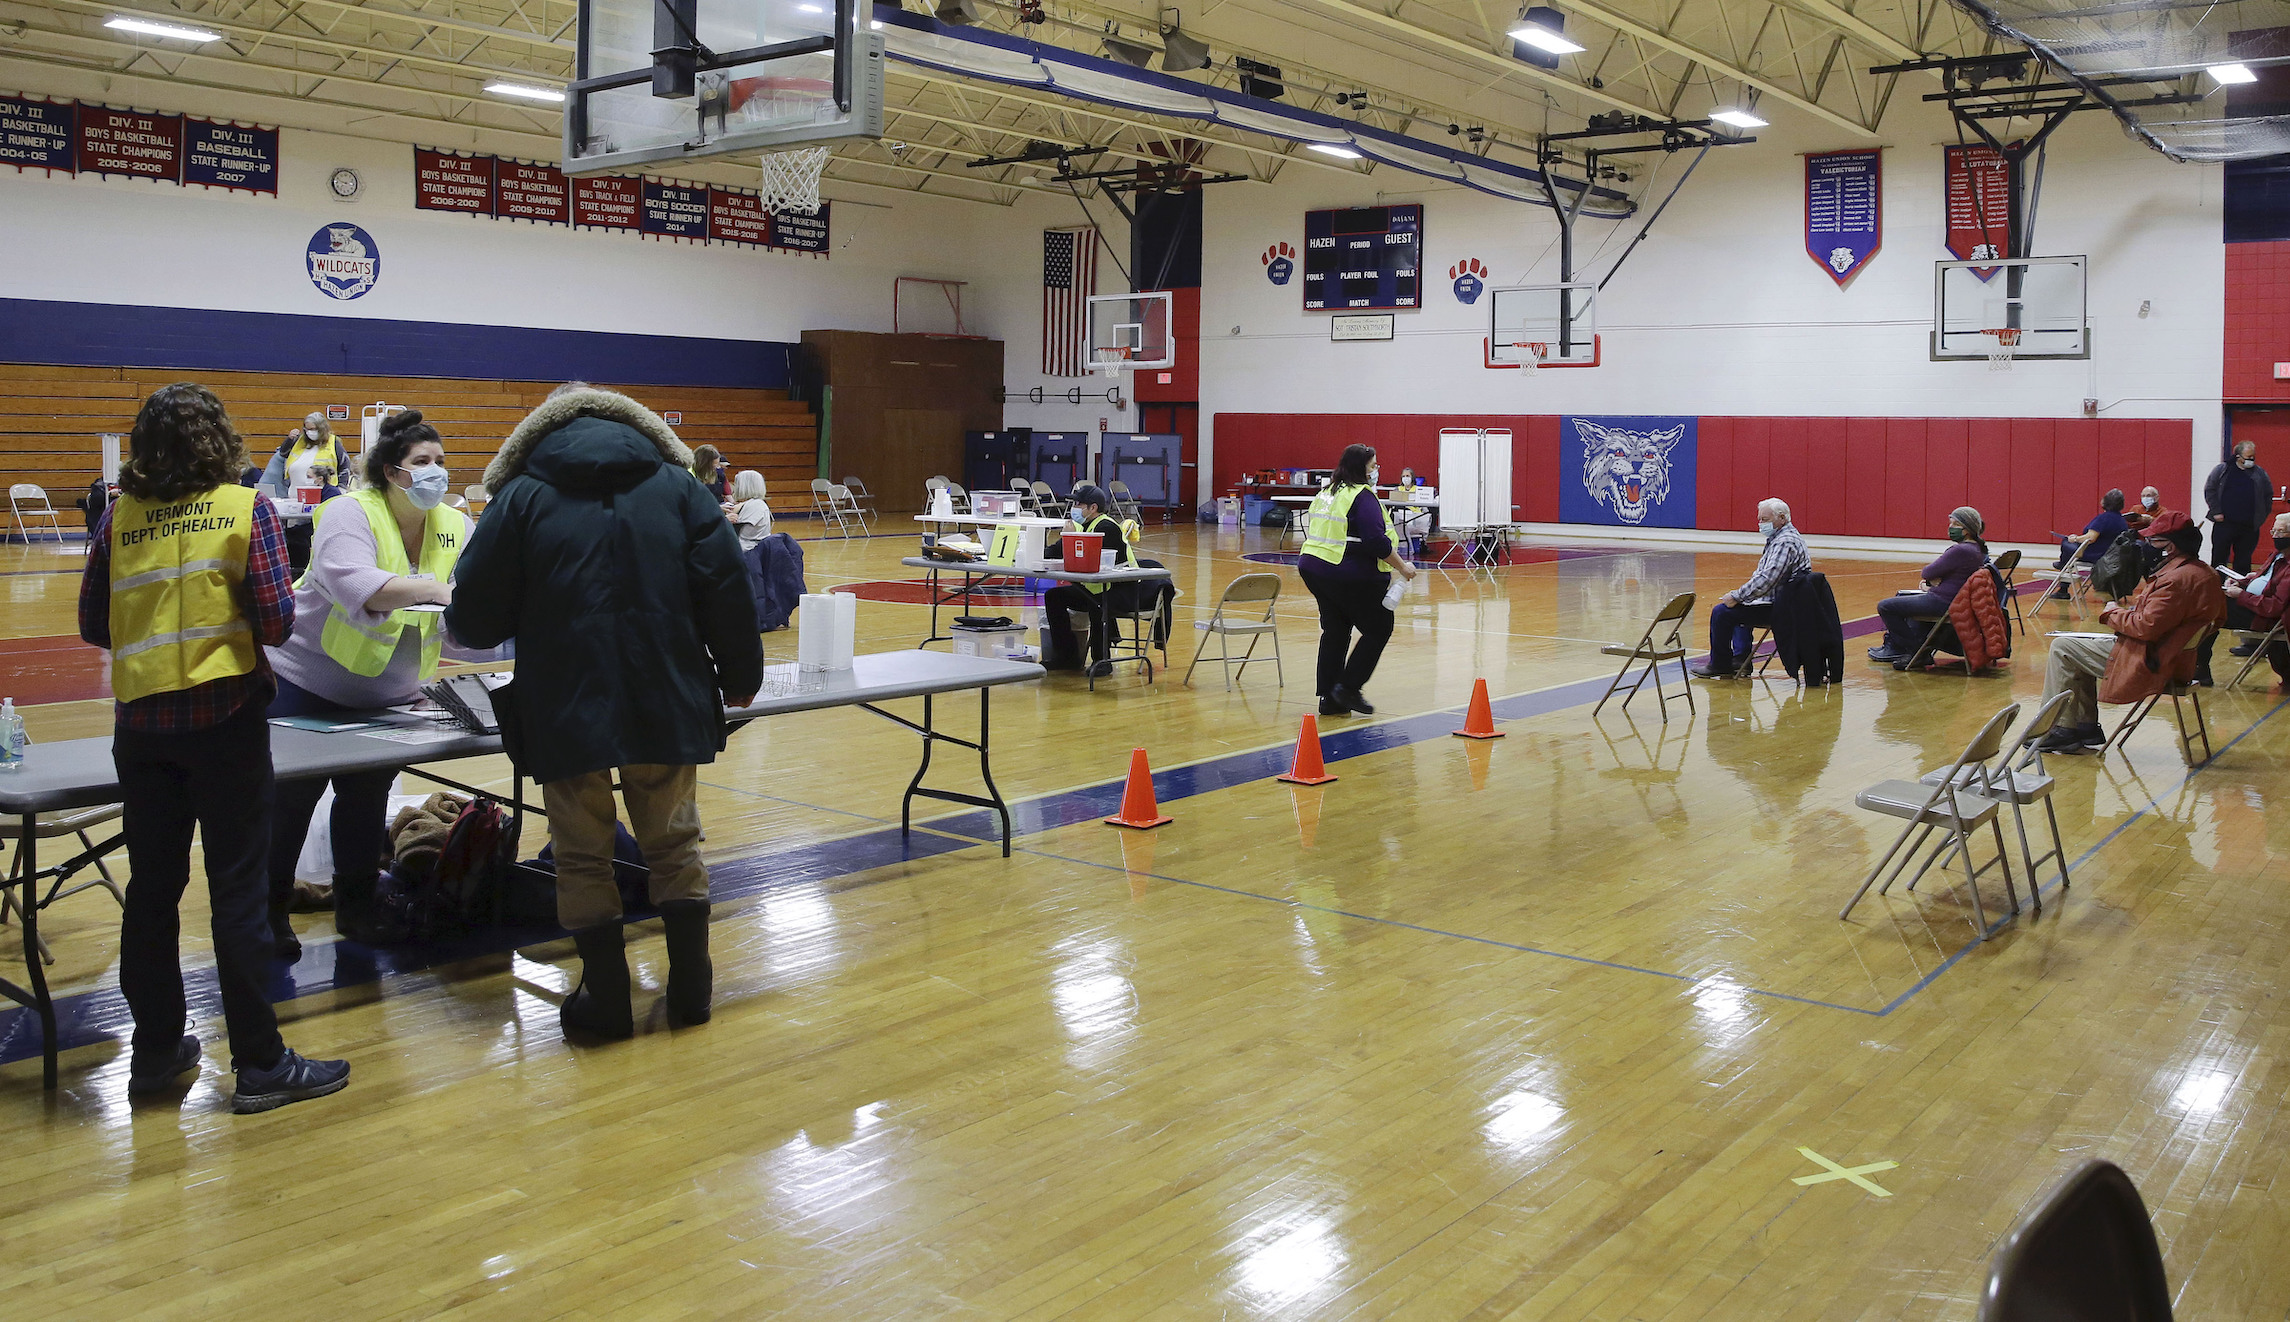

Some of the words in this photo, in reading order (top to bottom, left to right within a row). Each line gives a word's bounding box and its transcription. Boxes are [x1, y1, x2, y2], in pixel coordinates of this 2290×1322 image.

[0, 103, 23, 116] DIV.
[27, 107, 43, 119] III
[2, 118, 67, 137] BASKETBALL
[108, 116, 134, 129] DIV.
[138, 120, 153, 131] III
[8, 134, 66, 150] RUNNER-UP
[85, 126, 110, 139] BOYS
[114, 130, 175, 147] BASKETBALL
[211, 129, 235, 142] DIV.
[238, 133, 254, 144] III
[0, 147, 48, 161] 004-05
[87, 141, 118, 154] STATE
[122, 145, 173, 161] CHAMPIONS
[196, 141, 267, 160] BASEBALL
[97, 158, 163, 173] 2005-2006
[191, 154, 218, 167] STATE
[221, 158, 271, 173] RUNNER-UP
[439, 159, 458, 170] DIV.
[460, 162, 471, 171] III
[216, 171, 246, 182] 2007
[421, 169, 440, 180] BOYS
[442, 172, 487, 185] BASKETBALL
[517, 168, 536, 179] DIV.
[537, 171, 548, 181] III
[423, 182, 446, 194] STATE
[448, 185, 486, 197] CHAMPIONS
[501, 178, 519, 190] BOYS
[521, 181, 564, 194] BASKETBALL
[592, 180, 610, 190] DIV.
[611, 181, 622, 190] IV
[503, 191, 524, 202] STATE
[526, 193, 562, 206] CHAMPIONS
[579, 189, 594, 199] BOYS
[595, 191, 613, 201] TRACK
[620, 193, 636, 203] FIELD
[662, 189, 678, 199] DIV.
[680, 192, 691, 201] III
[727, 197, 743, 207] DIV.
[744, 199, 754, 208] III
[509, 204, 557, 216] 2009-2010
[579, 201, 600, 212] STATE
[600, 203, 635, 214] CHAMPIONS
[645, 198, 669, 209] BOYS
[670, 202, 706, 213] SOCCER
[713, 205, 729, 215] BOYS
[730, 208, 766, 220] BASKETBALL
[586, 213, 628, 224] 2011-2012
[649, 209, 668, 220] STATE
[777, 213, 791, 224] BOYS
[792, 216, 826, 228] BASKETBALL
[1392, 215, 1415, 223] DASANI
[665, 222, 686, 231] 2014
[714, 216, 733, 227] STATE
[734, 219, 765, 231] CHAMPIONS
[777, 224, 794, 235] STATE
[1309, 237, 1336, 249] HAZEN
[1349, 240, 1371, 249] PERIOD
[1384, 233, 1413, 245] GUEST
[316, 258, 371, 275] WILDCATS
[1306, 273, 1325, 281] FOULS
[1340, 271, 1362, 280] PLAYER
[1364, 271, 1379, 279] FOUL
[1396, 269, 1415, 278] FOULS
[323, 281, 344, 298] HAZEN
[344, 283, 364, 298] UNION
[1305, 300, 1325, 308] SCORE
[1349, 299, 1370, 307] MATCH
[1395, 297, 1415, 306] SCORE
[146, 502, 214, 523] VERMONT
[121, 527, 159, 546] DEPT.
[162, 522, 180, 538] OF
[182, 517, 235, 534] HEALTH
[997, 535, 1009, 558] 1
